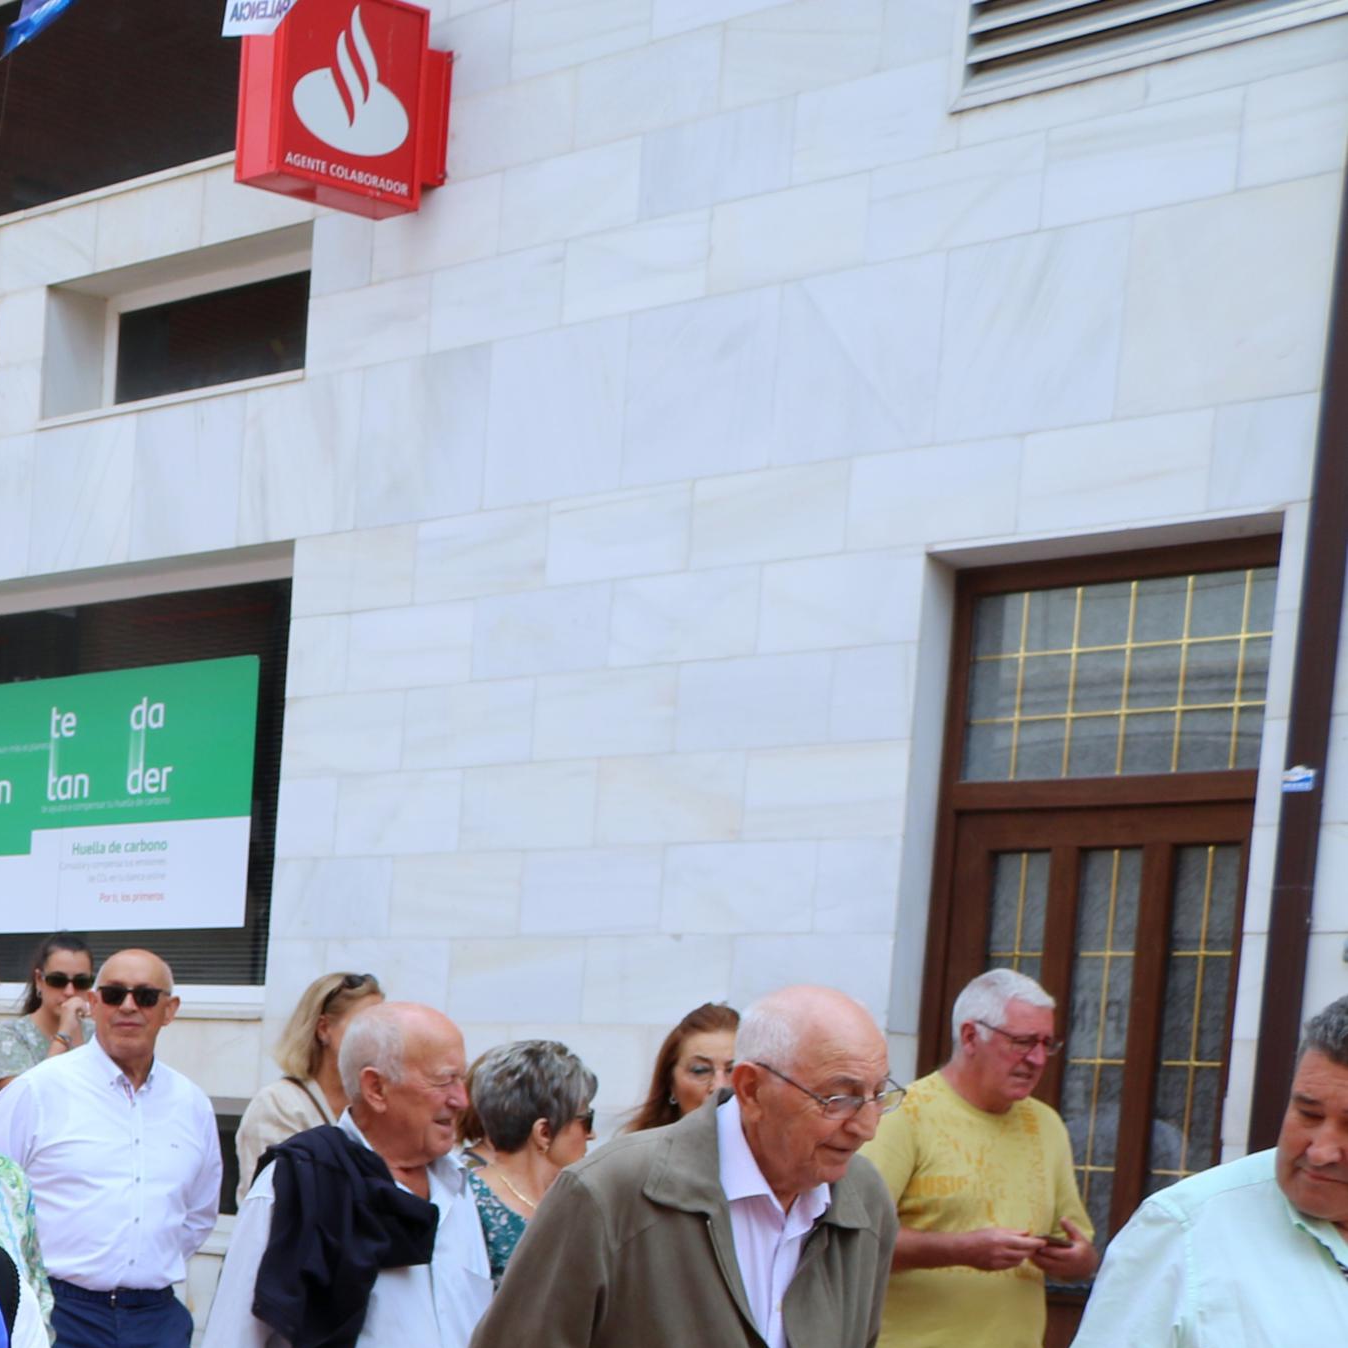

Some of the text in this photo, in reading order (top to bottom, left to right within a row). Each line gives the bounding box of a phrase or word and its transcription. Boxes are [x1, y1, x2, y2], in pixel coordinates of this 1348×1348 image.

[284, 151, 409, 196] AGENTE COLABORADOR
[50, 706, 78, 740] te
[130, 697, 165, 731] da
[47, 766, 90, 802] tan
[126, 765, 174, 796] der
[72, 838, 167, 855] Huella de carbono
